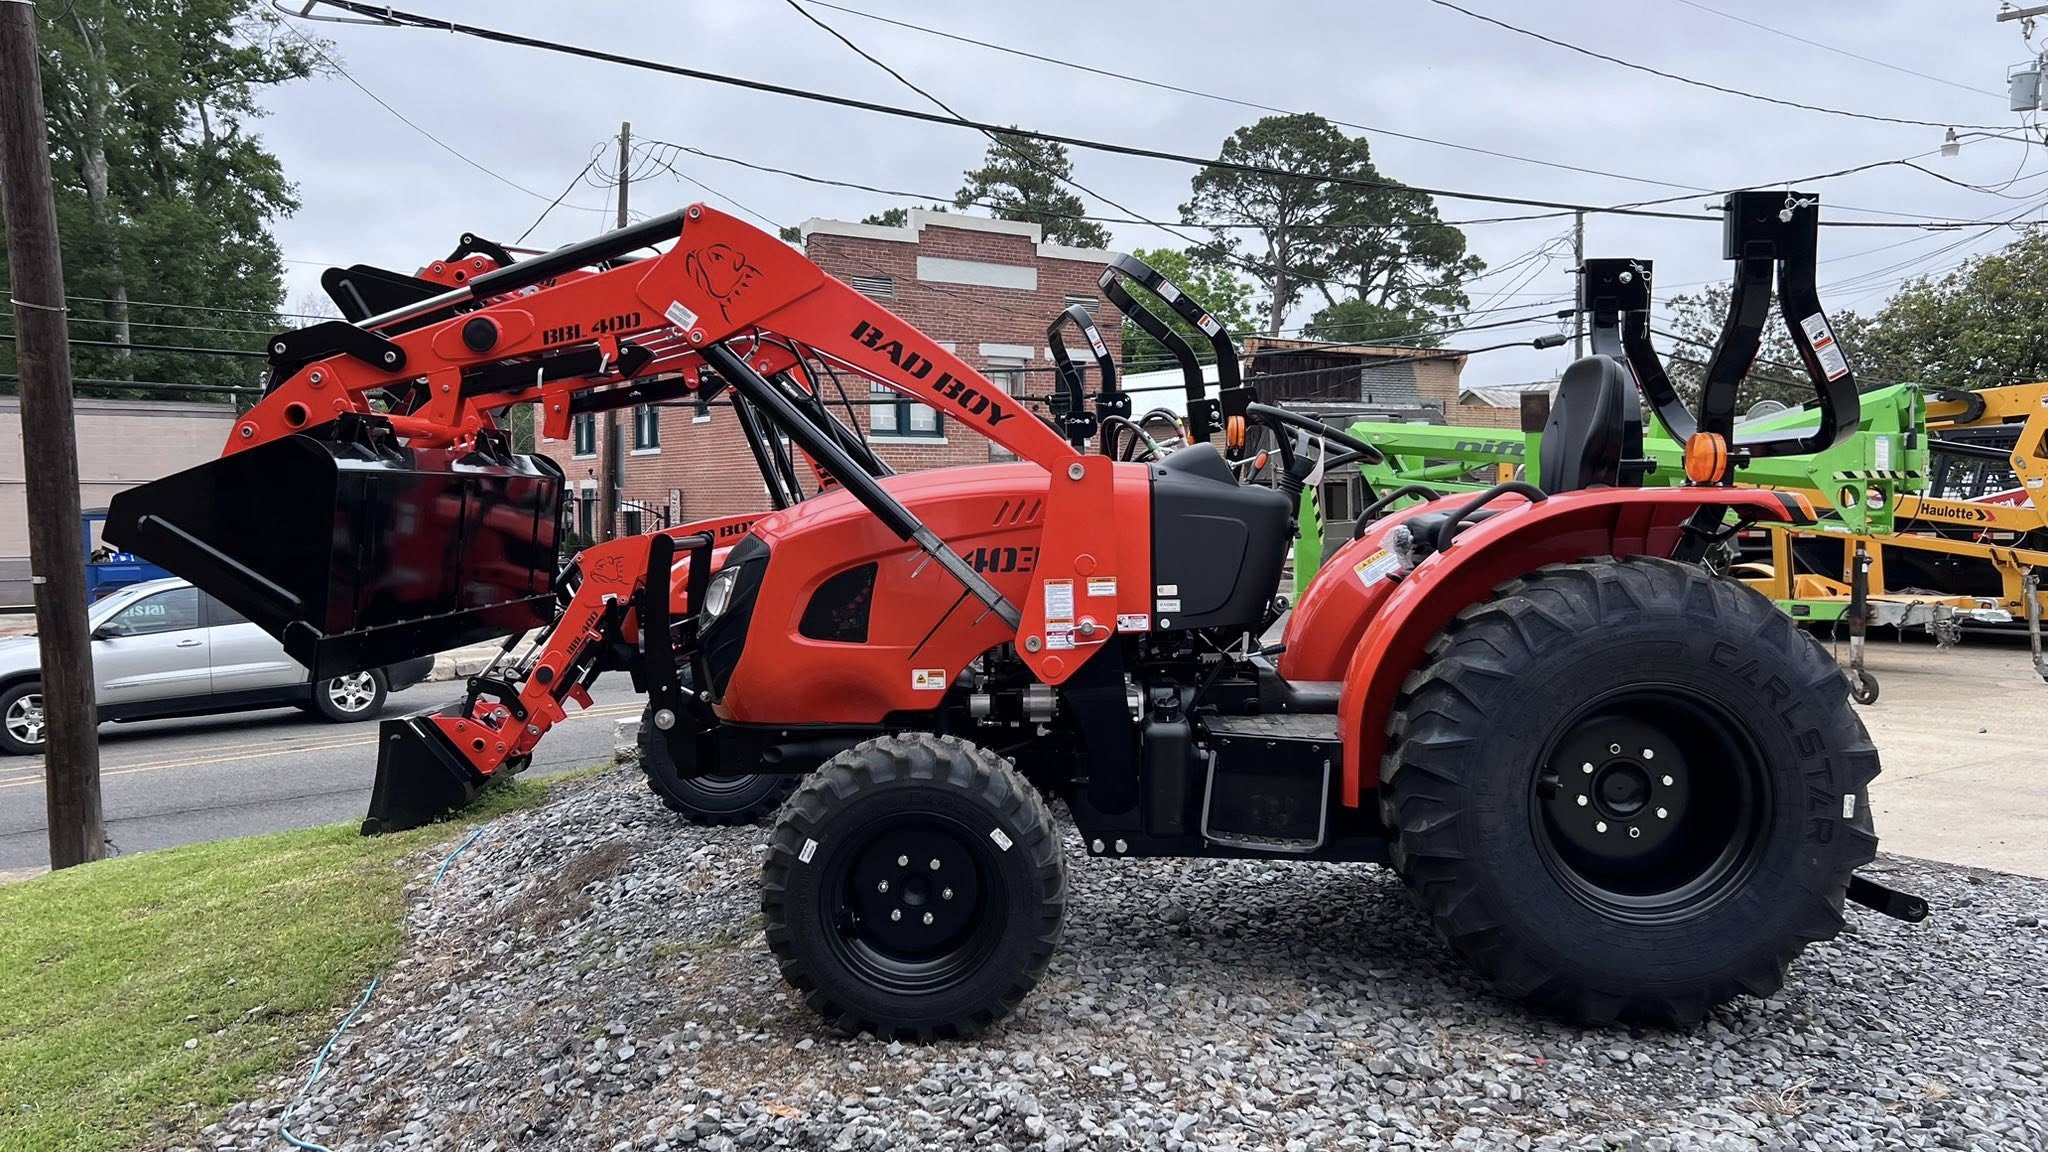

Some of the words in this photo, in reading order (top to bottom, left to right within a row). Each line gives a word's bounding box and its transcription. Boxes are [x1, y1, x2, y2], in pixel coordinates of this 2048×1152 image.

[543, 324, 588, 345] BBL
[592, 312, 641, 334] 400
[850, 320, 933, 380] BAD
[932, 371, 1016, 427] BOY
[1920, 503, 1974, 520] Haulotte
[1708, 640, 1836, 846] CARLSTAR
